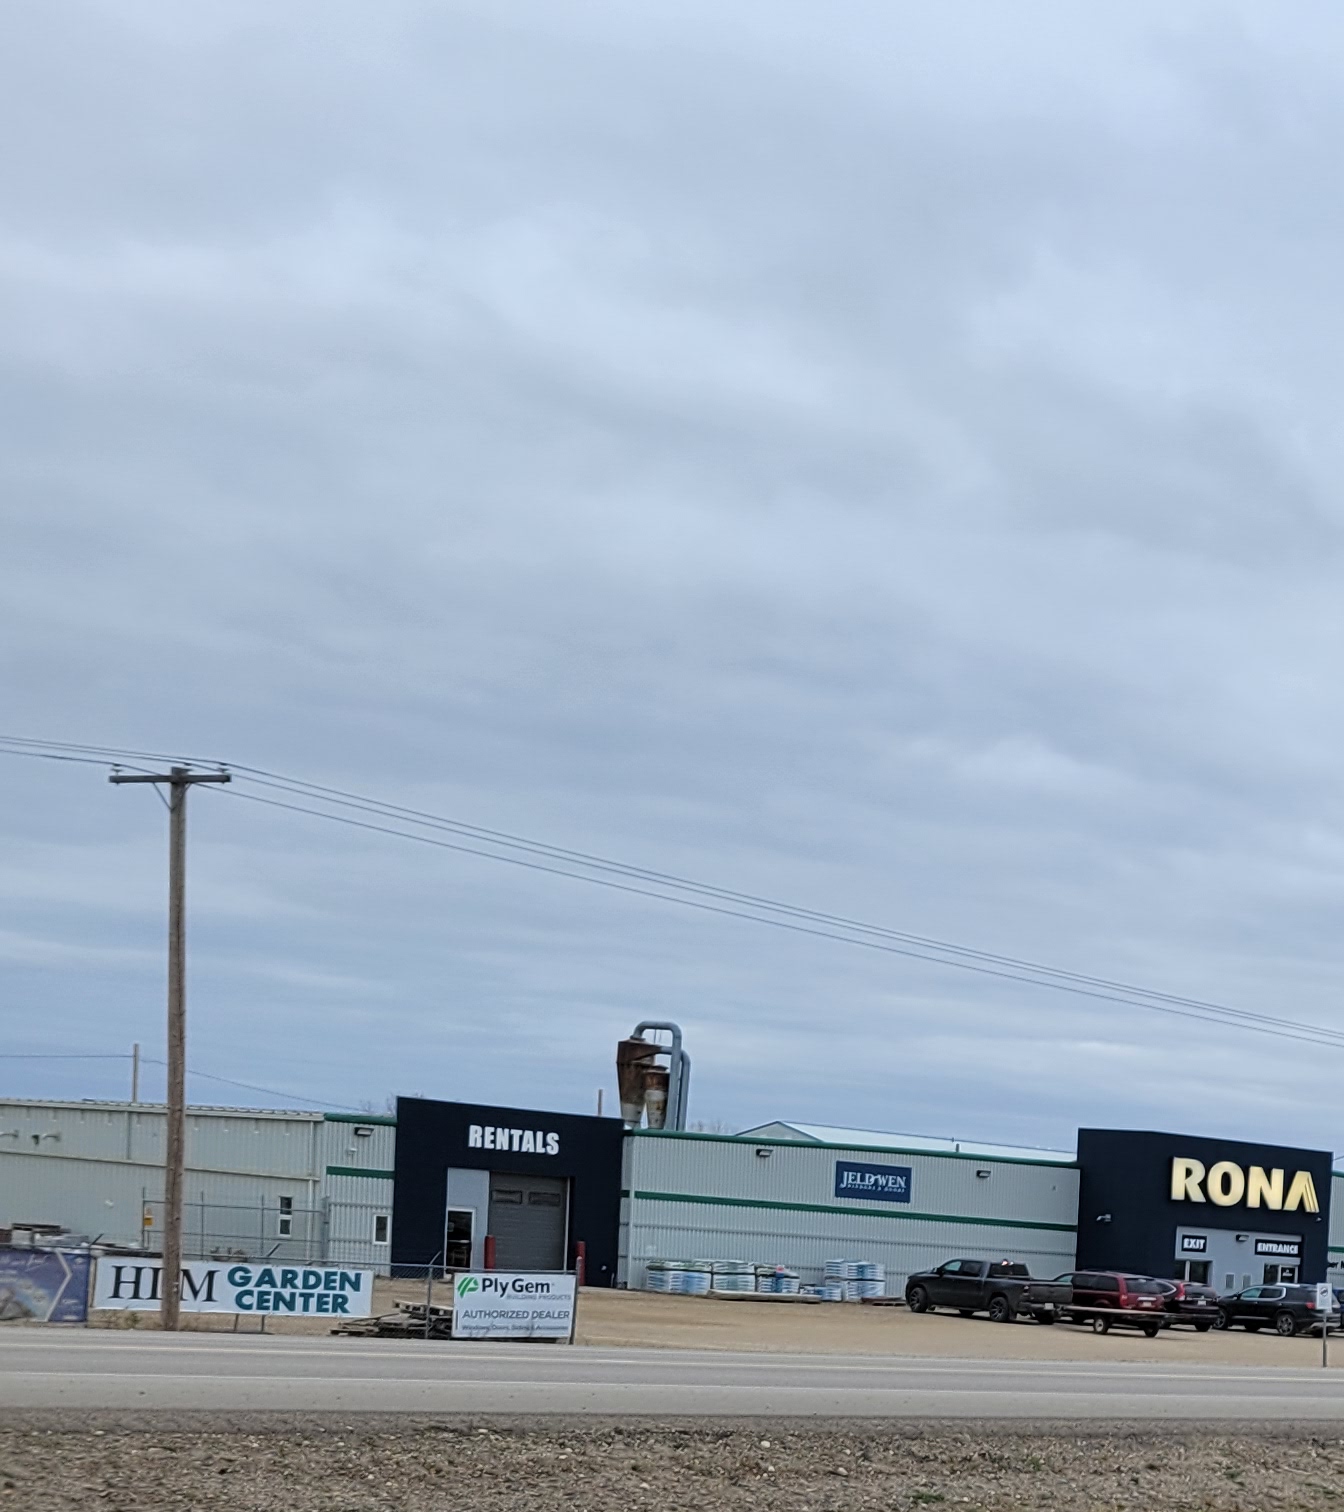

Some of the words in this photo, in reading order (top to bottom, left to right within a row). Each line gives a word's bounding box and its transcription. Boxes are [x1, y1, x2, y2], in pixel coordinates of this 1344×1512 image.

[468, 1124, 560, 1155] RENTALS
[1170, 1156, 1320, 1213] RONA
[1183, 1238, 1206, 1250] EXIT
[1257, 1242, 1299, 1254] ENTRANCE
[227, 1265, 362, 1292] GARDEN
[481, 1277, 509, 1298] Ply
[511, 1278, 551, 1293] Gem
[234, 1290, 351, 1313] CENTER
[462, 1309, 530, 1319] AUTHORIZED
[531, 1310, 570, 1319] DEALER
